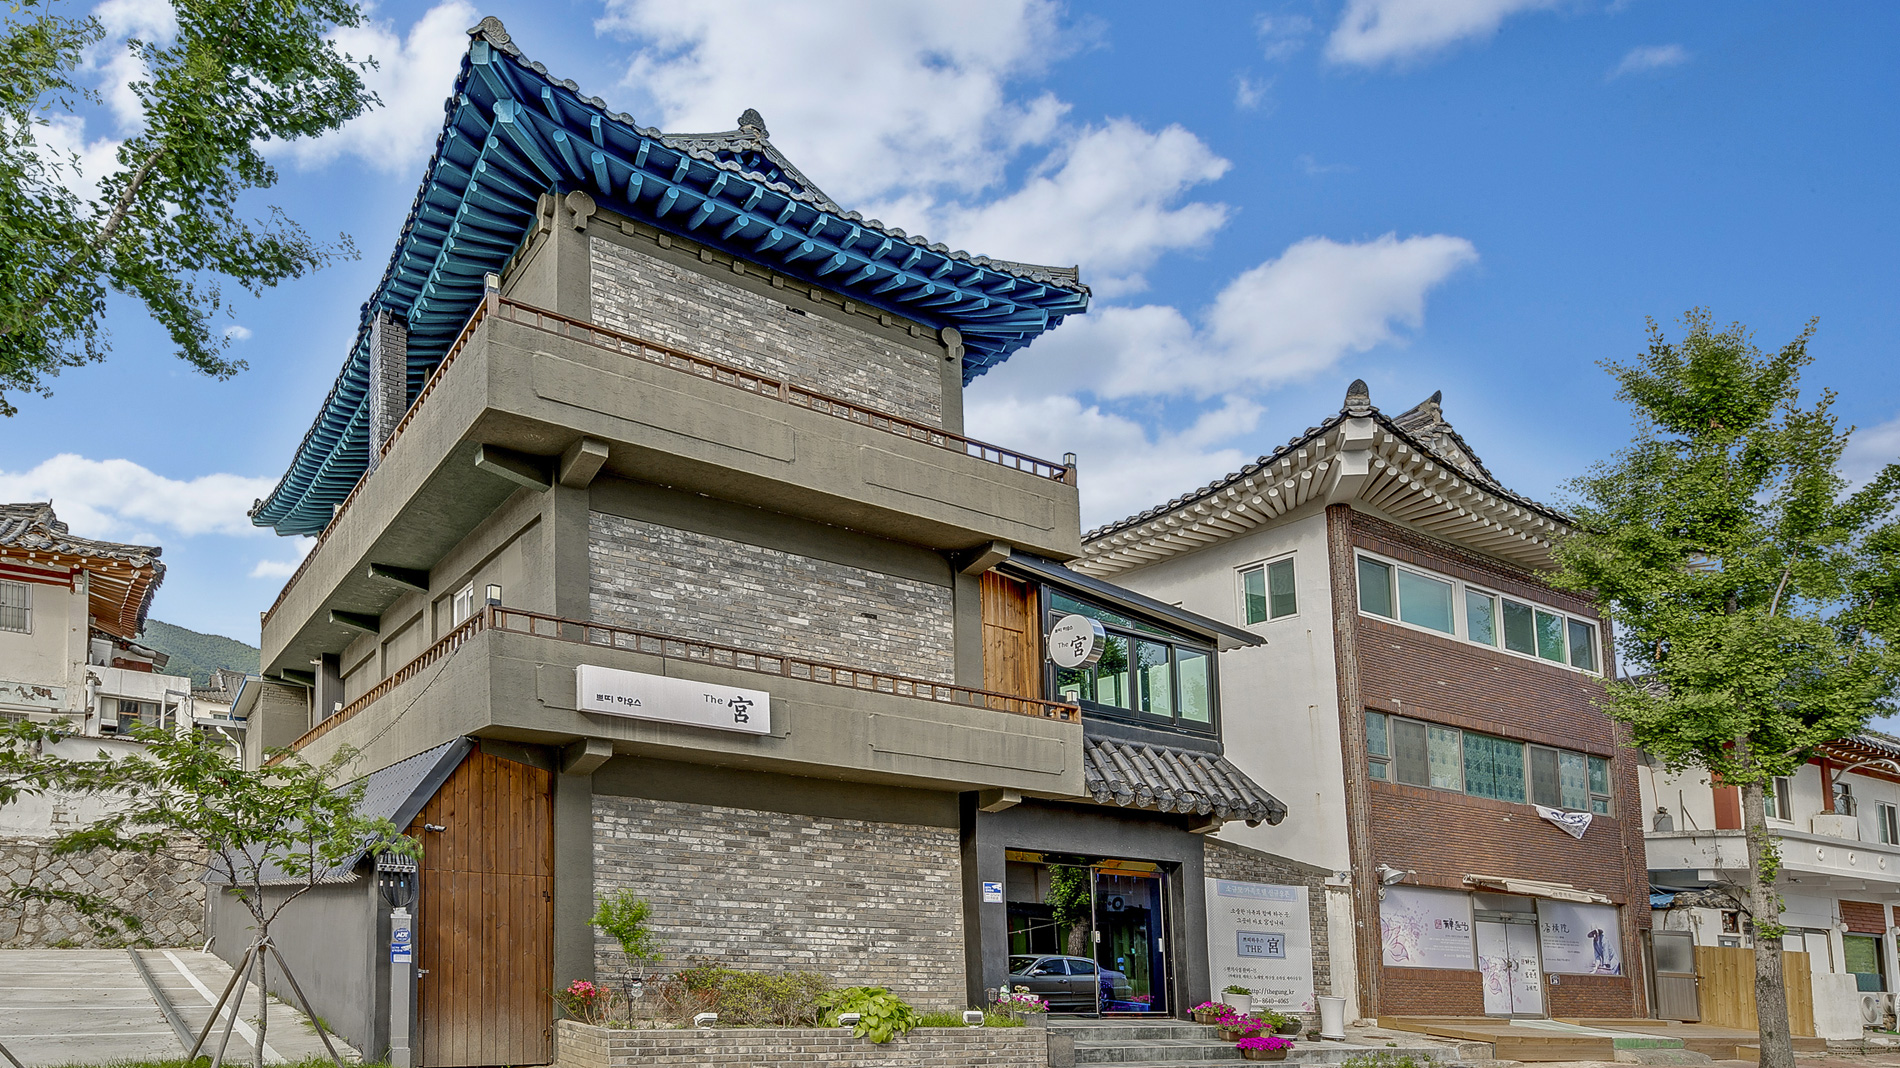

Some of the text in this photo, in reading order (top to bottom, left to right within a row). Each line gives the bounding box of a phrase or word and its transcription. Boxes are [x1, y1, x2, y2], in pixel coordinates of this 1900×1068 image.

[1070, 635, 1087, 658] 宮
[596, 693, 642, 707] 쁘띠 하우스
[703, 694, 754, 724] The 宮
[1246, 938, 1279, 954] THE 宮
